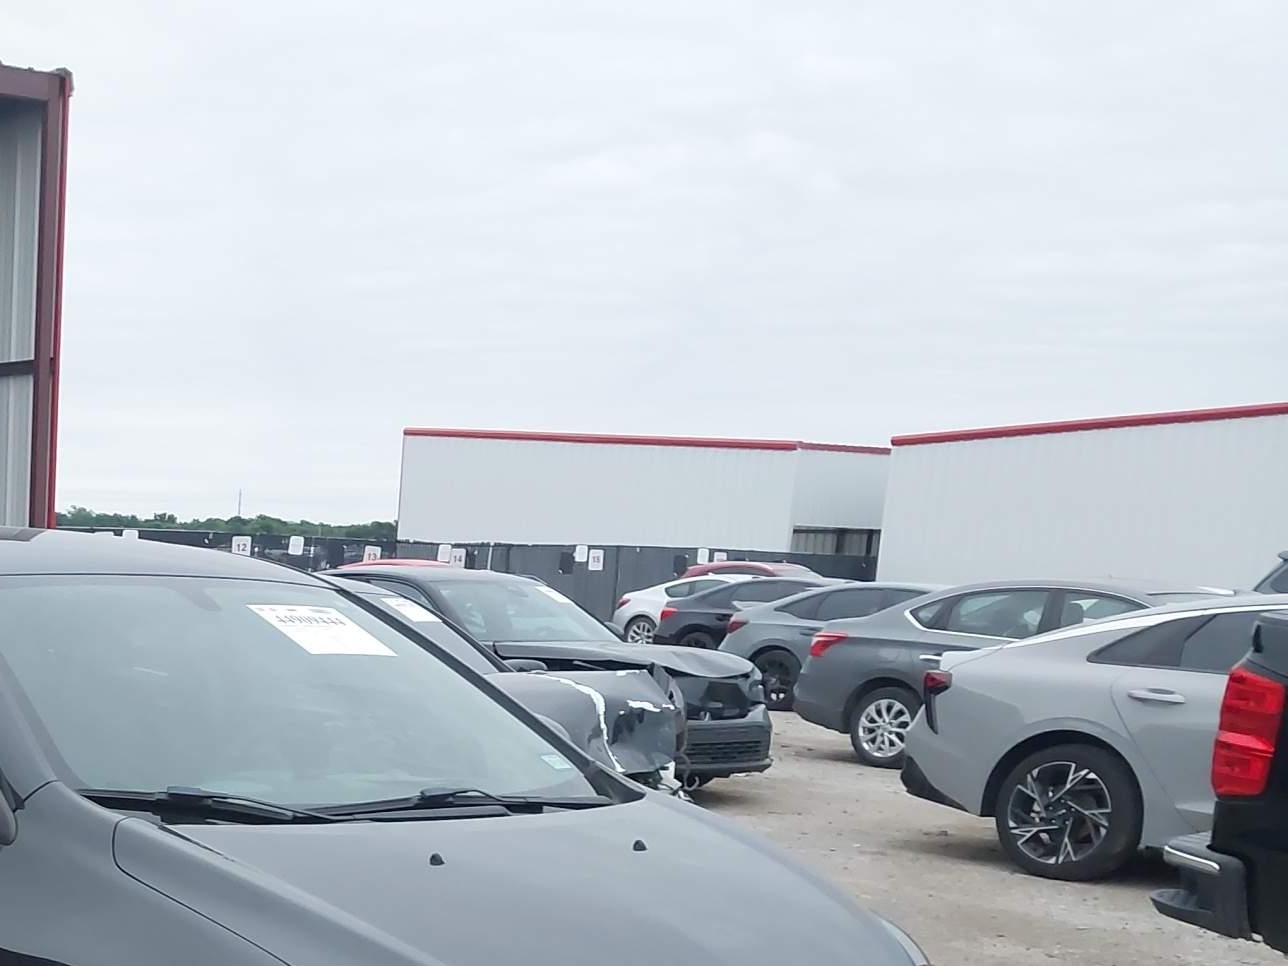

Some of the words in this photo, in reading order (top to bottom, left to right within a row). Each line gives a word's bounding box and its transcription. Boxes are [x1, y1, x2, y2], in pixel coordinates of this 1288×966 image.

[236, 543, 248, 553] 12
[367, 552, 378, 561] 13
[453, 554, 463, 563] 14
